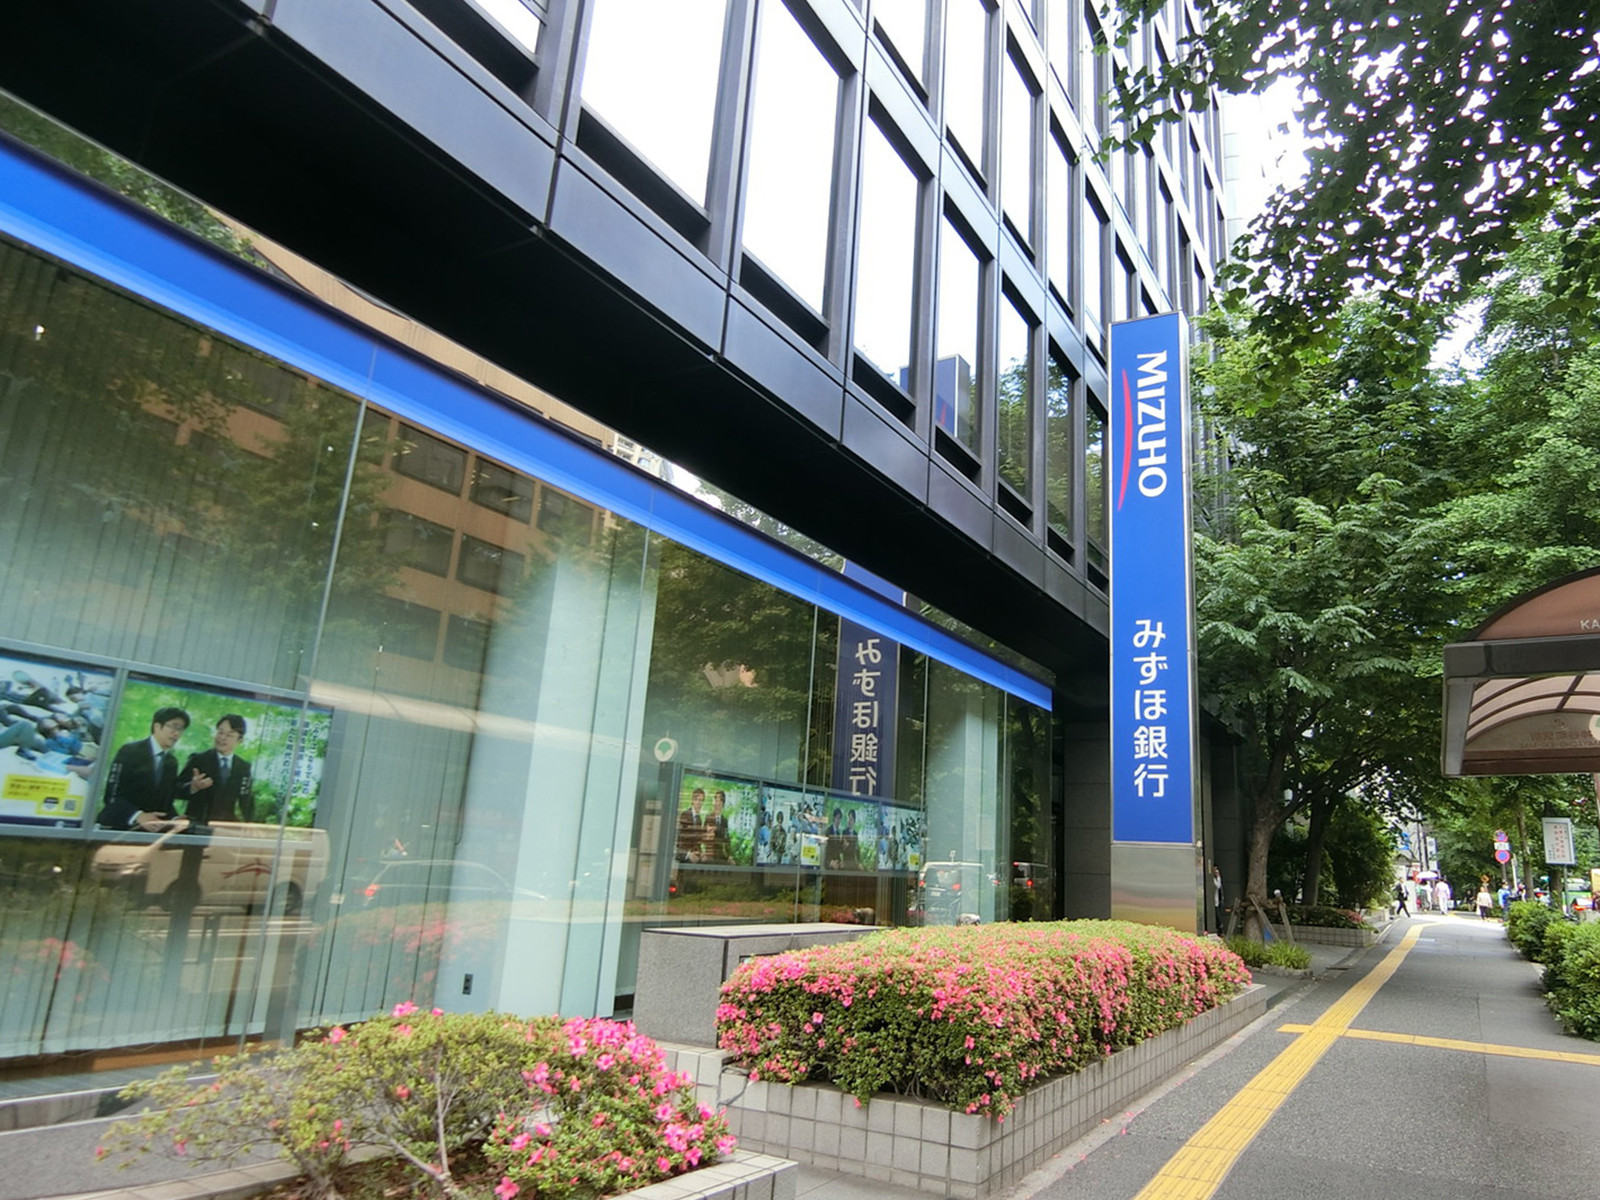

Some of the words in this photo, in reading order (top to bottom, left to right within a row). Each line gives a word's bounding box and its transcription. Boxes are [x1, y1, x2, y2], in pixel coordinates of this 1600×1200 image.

[1137, 350, 1168, 498] MIZUHO
[1132, 619, 1169, 798] みずほ銀行
